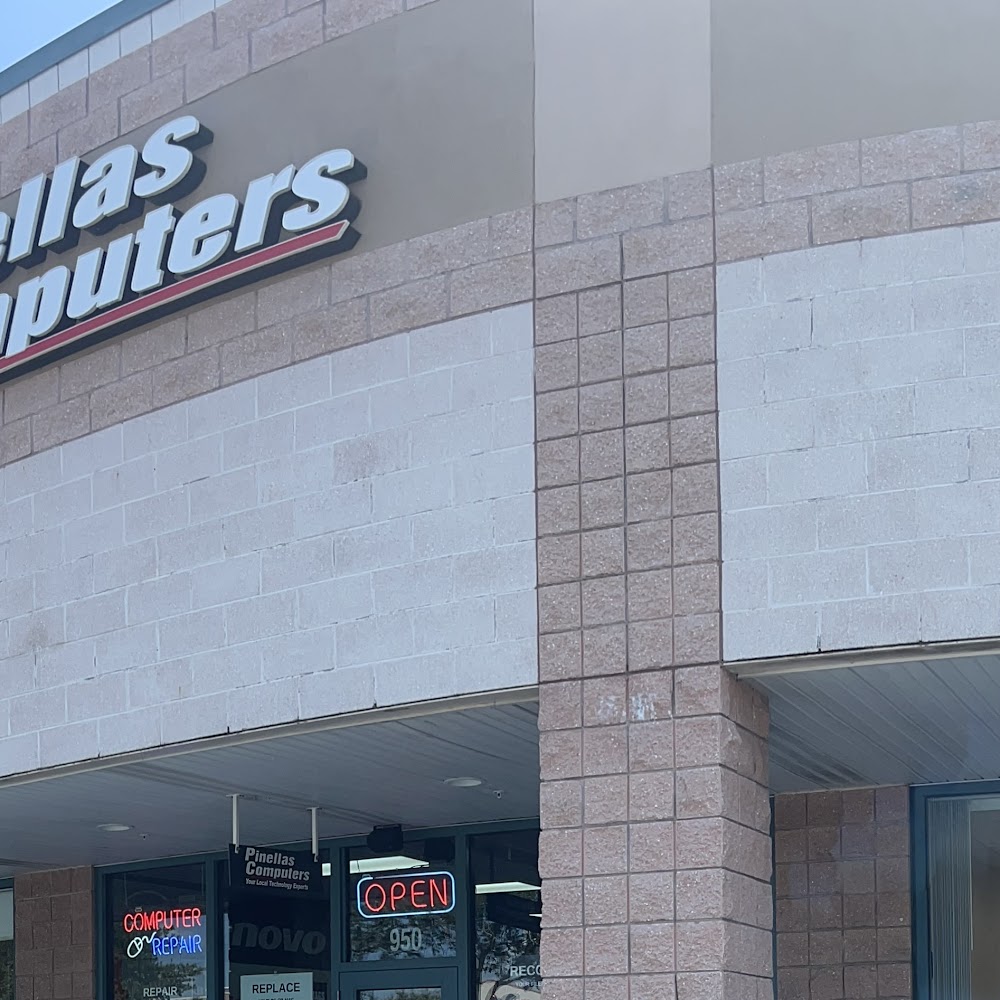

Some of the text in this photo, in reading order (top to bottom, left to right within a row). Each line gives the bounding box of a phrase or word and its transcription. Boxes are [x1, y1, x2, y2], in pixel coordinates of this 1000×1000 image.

[0, 115, 200, 263] llas
[0, 148, 355, 358] puters
[244, 847, 296, 866] Pinellas
[245, 861, 310, 881] Computers
[256, 879, 268, 887] Local
[364, 878, 448, 912] OPEN
[123, 907, 201, 933] COMPUTER
[152, 934, 202, 956] REPAIR
[389, 927, 422, 951] 950
[143, 986, 178, 997] REPAIR
[252, 983, 301, 994] REPLACE
